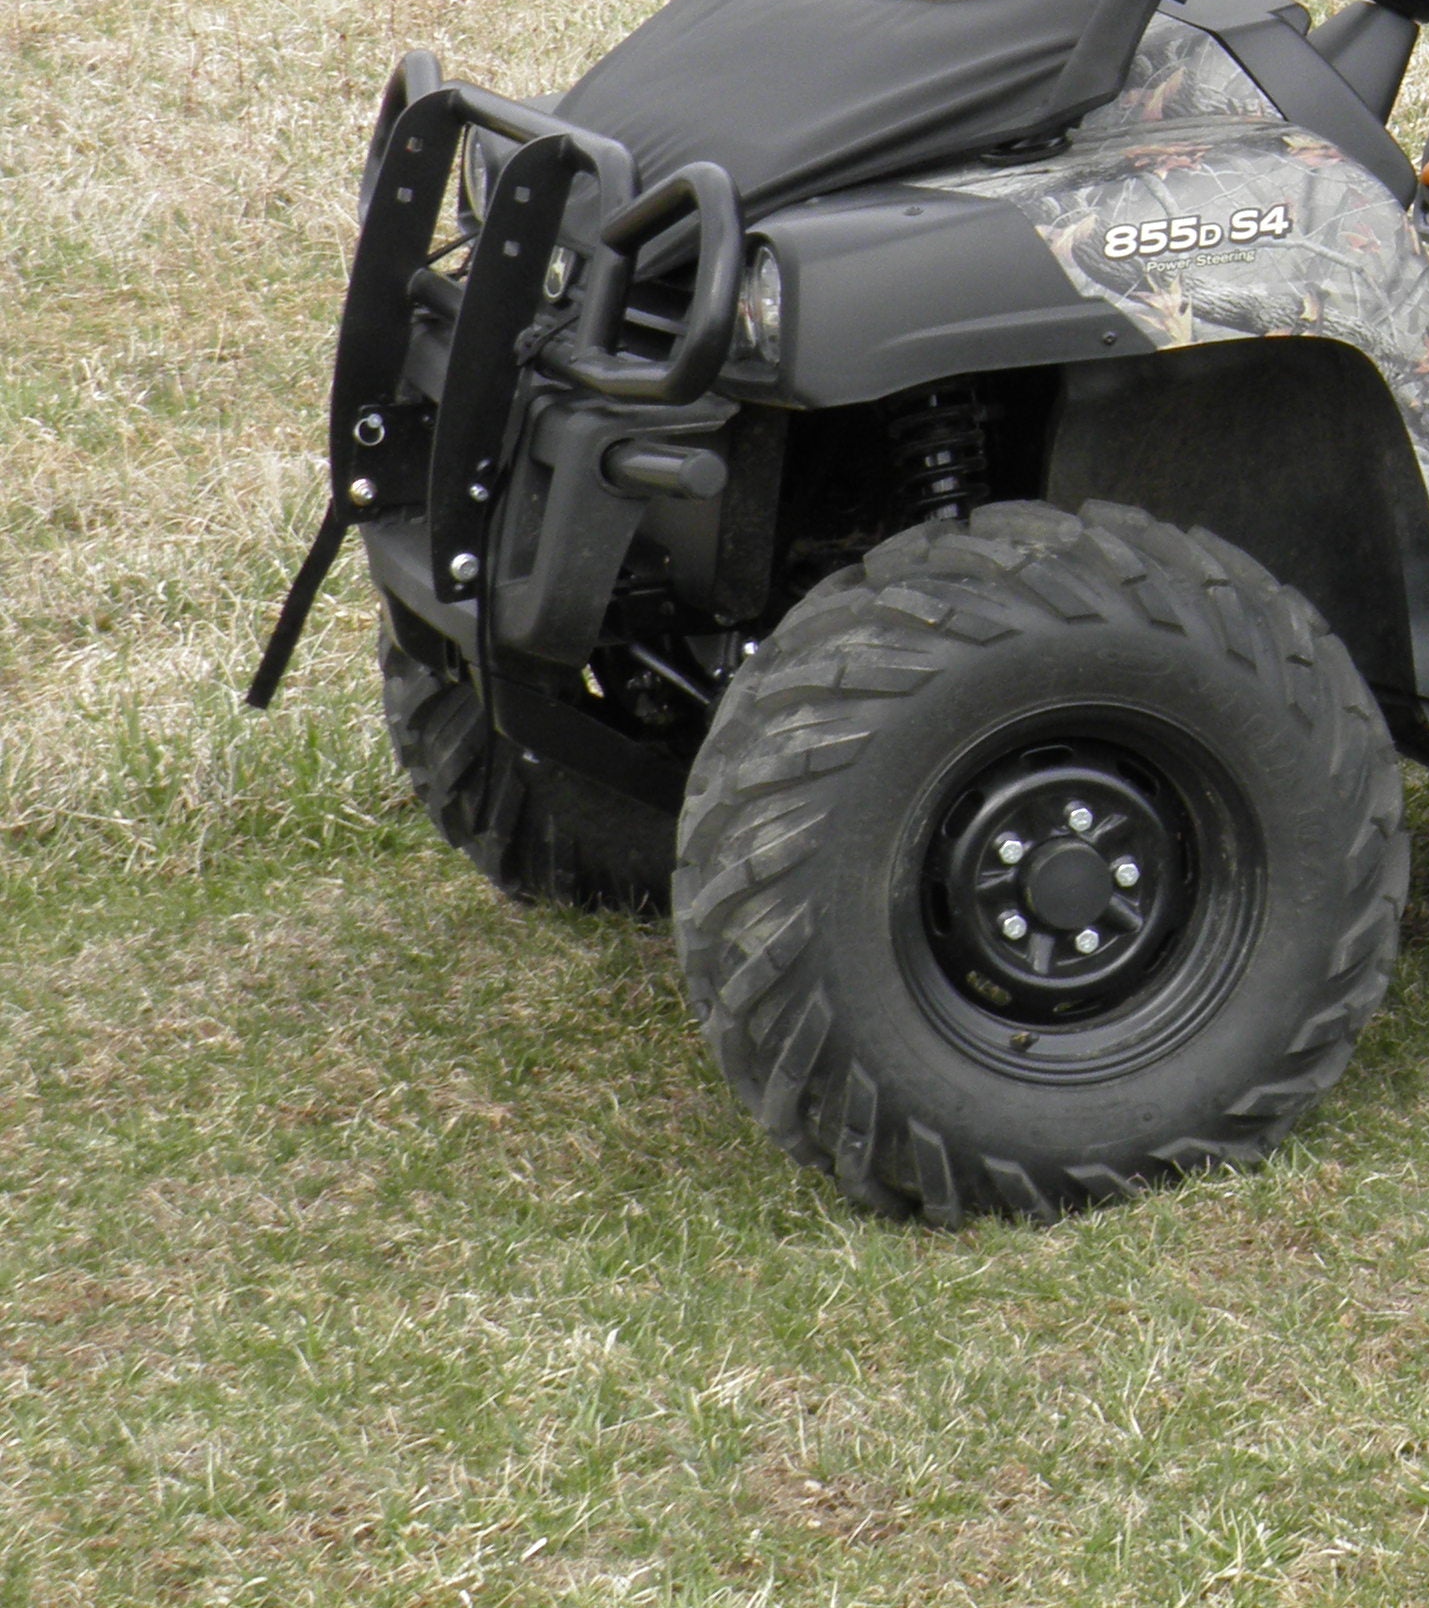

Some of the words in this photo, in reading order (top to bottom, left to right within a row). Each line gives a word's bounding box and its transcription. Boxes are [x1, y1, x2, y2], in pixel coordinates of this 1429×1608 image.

[1103, 217, 1223, 260] 855D
[1229, 204, 1291, 242] S4
[1146, 259, 1191, 273] Power
[1196, 249, 1256, 268] Steering
